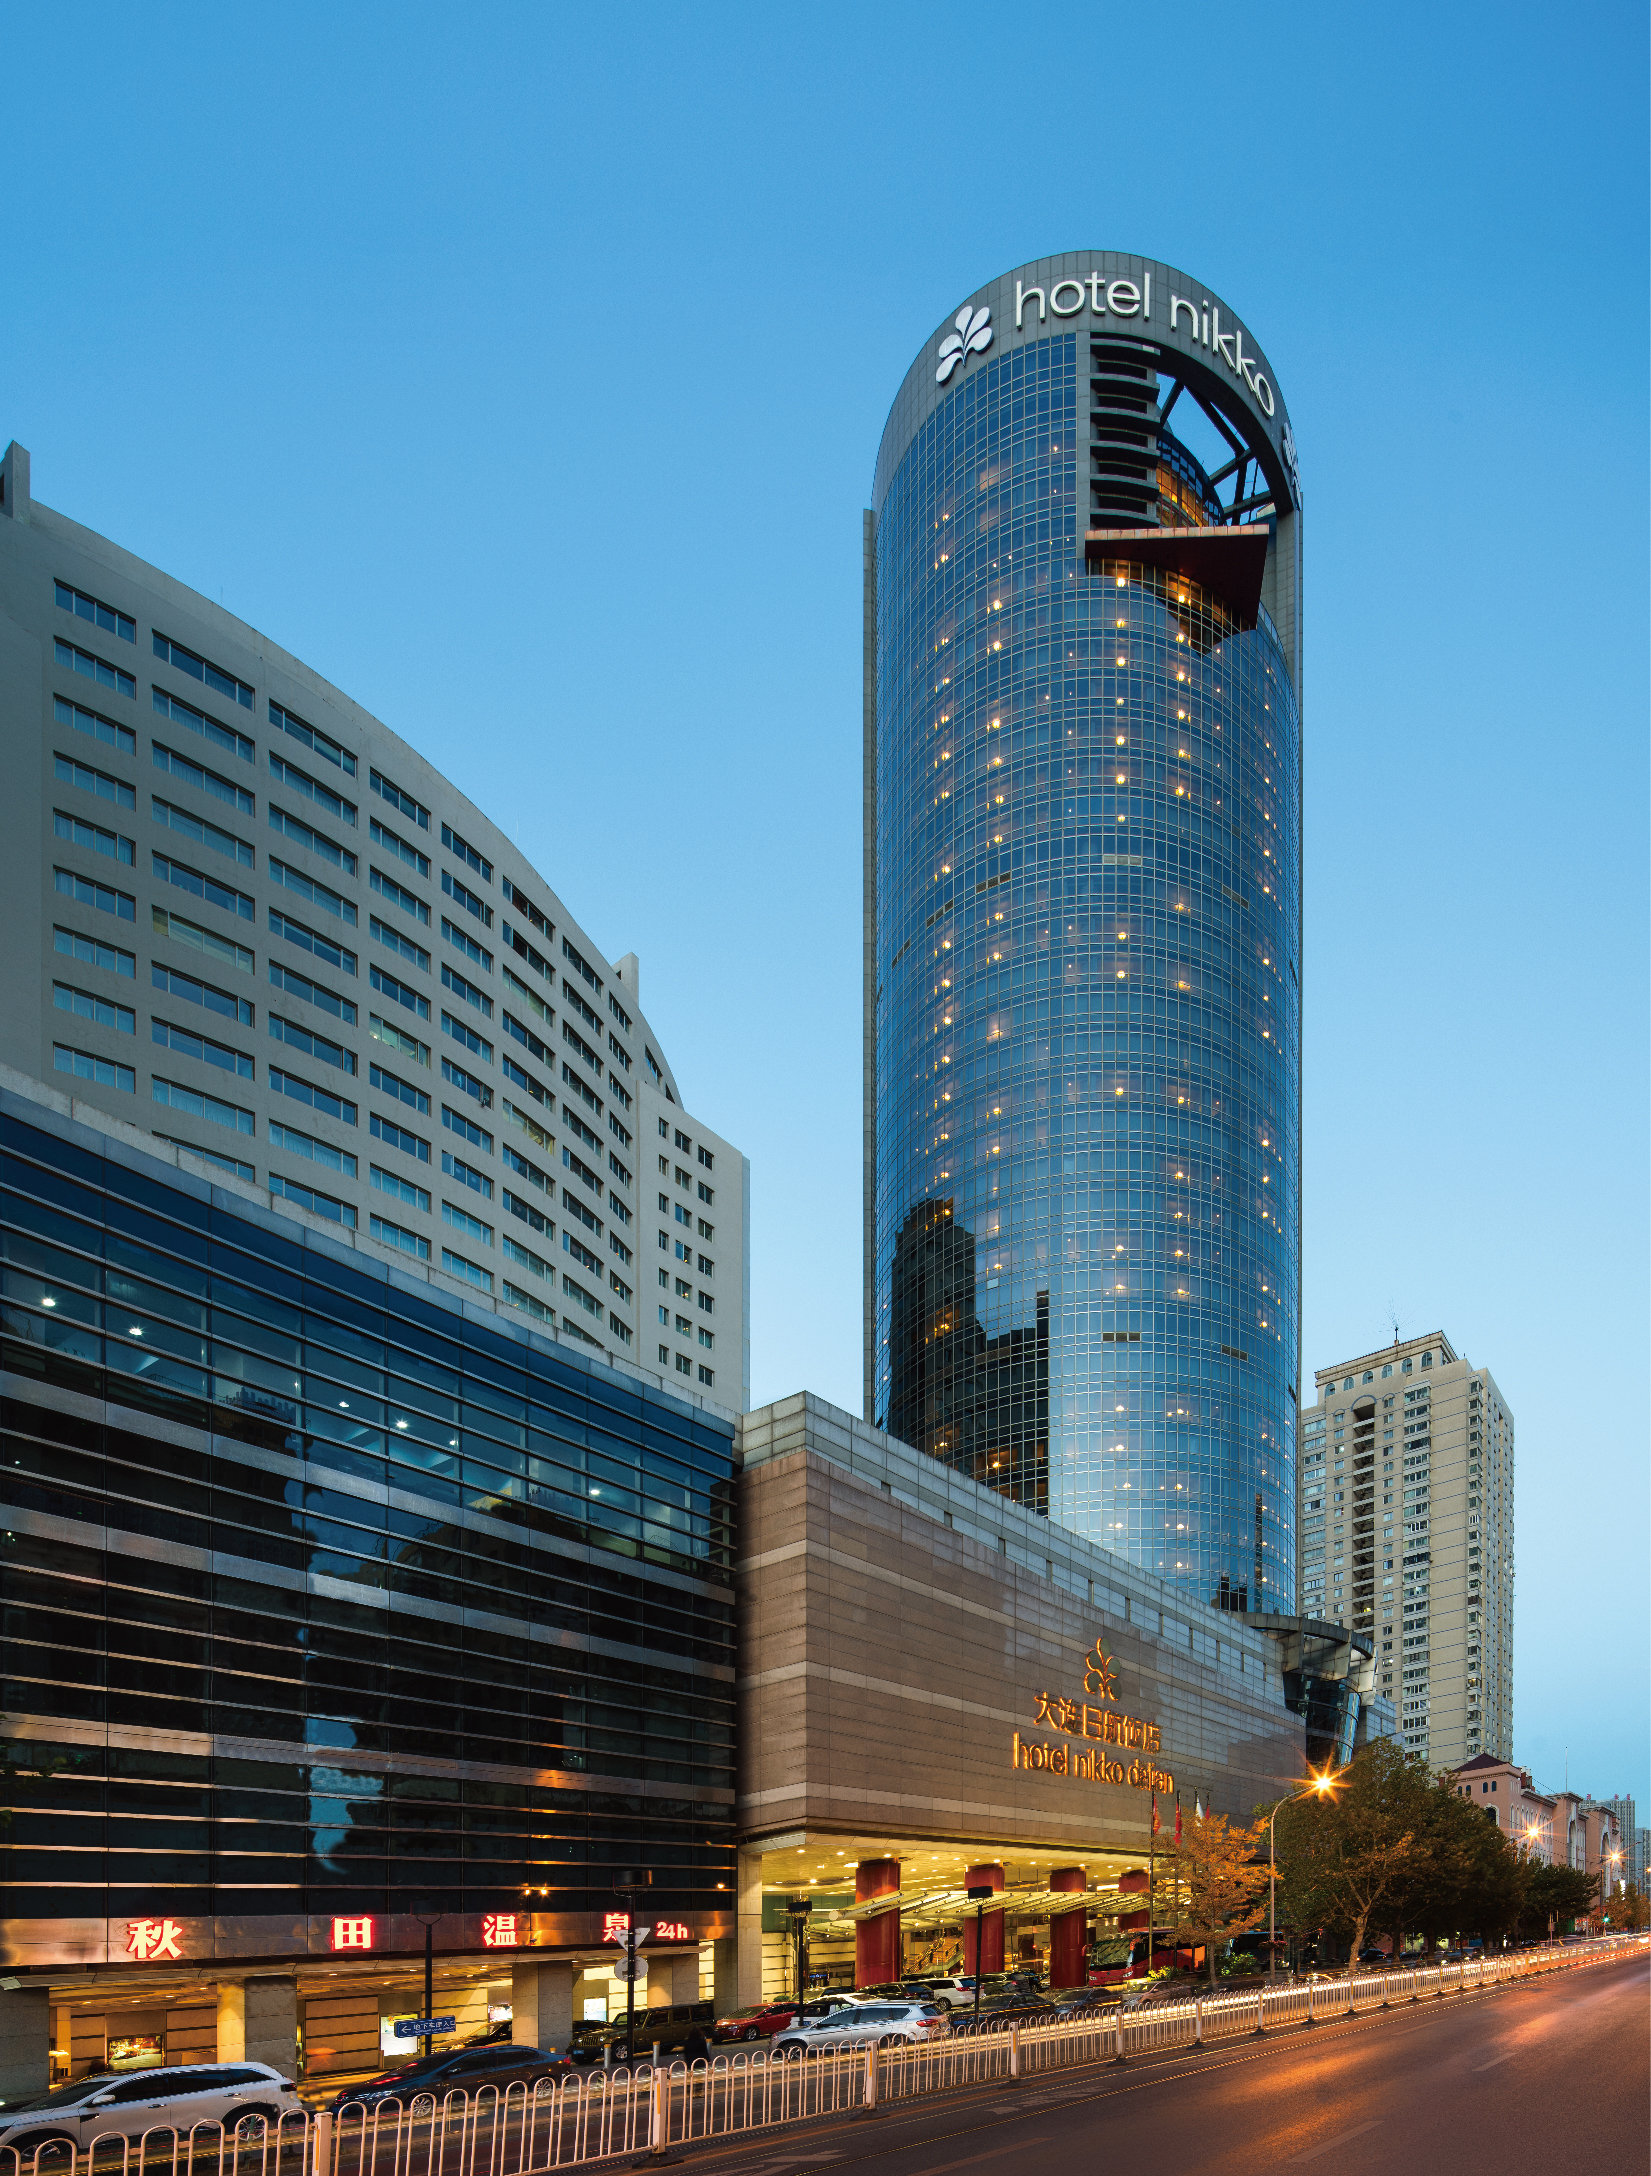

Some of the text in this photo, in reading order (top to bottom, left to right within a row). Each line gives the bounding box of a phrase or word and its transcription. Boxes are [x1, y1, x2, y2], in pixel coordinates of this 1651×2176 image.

[1016, 271, 1275, 417] hotel nikko
[1013, 1732, 1174, 1794] hotel nikko dalian
[656, 1921, 688, 1939] 24h
